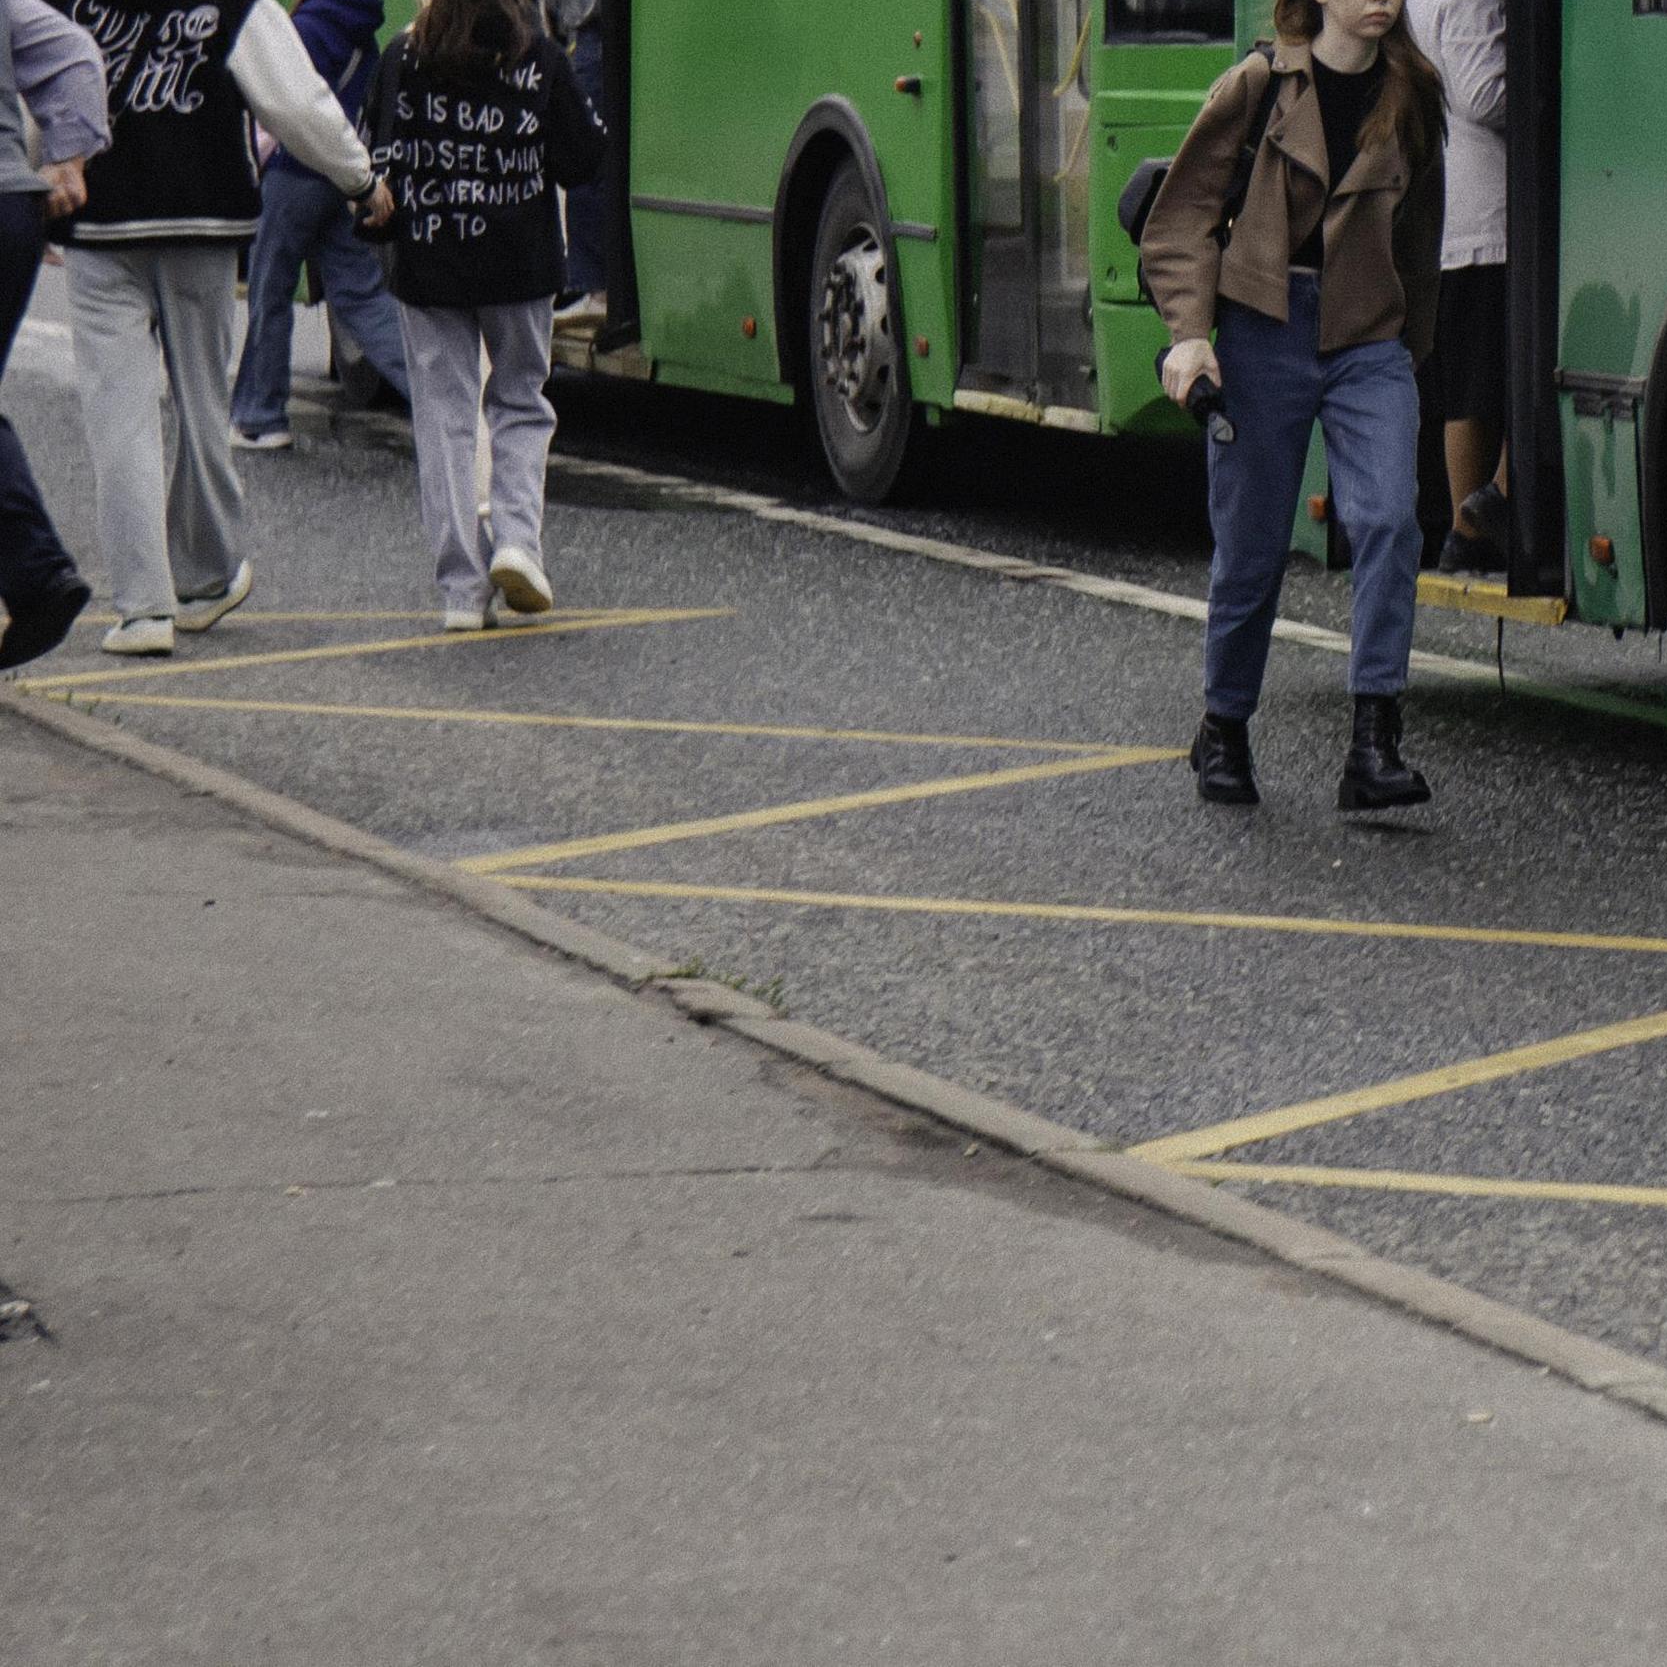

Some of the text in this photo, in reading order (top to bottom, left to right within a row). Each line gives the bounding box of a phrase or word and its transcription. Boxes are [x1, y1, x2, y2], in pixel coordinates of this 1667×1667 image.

[426, 92, 448, 124] IS
[458, 101, 504, 134] BAD
[438, 140, 489, 173] SEE
[411, 213, 488, 245] UP TO
